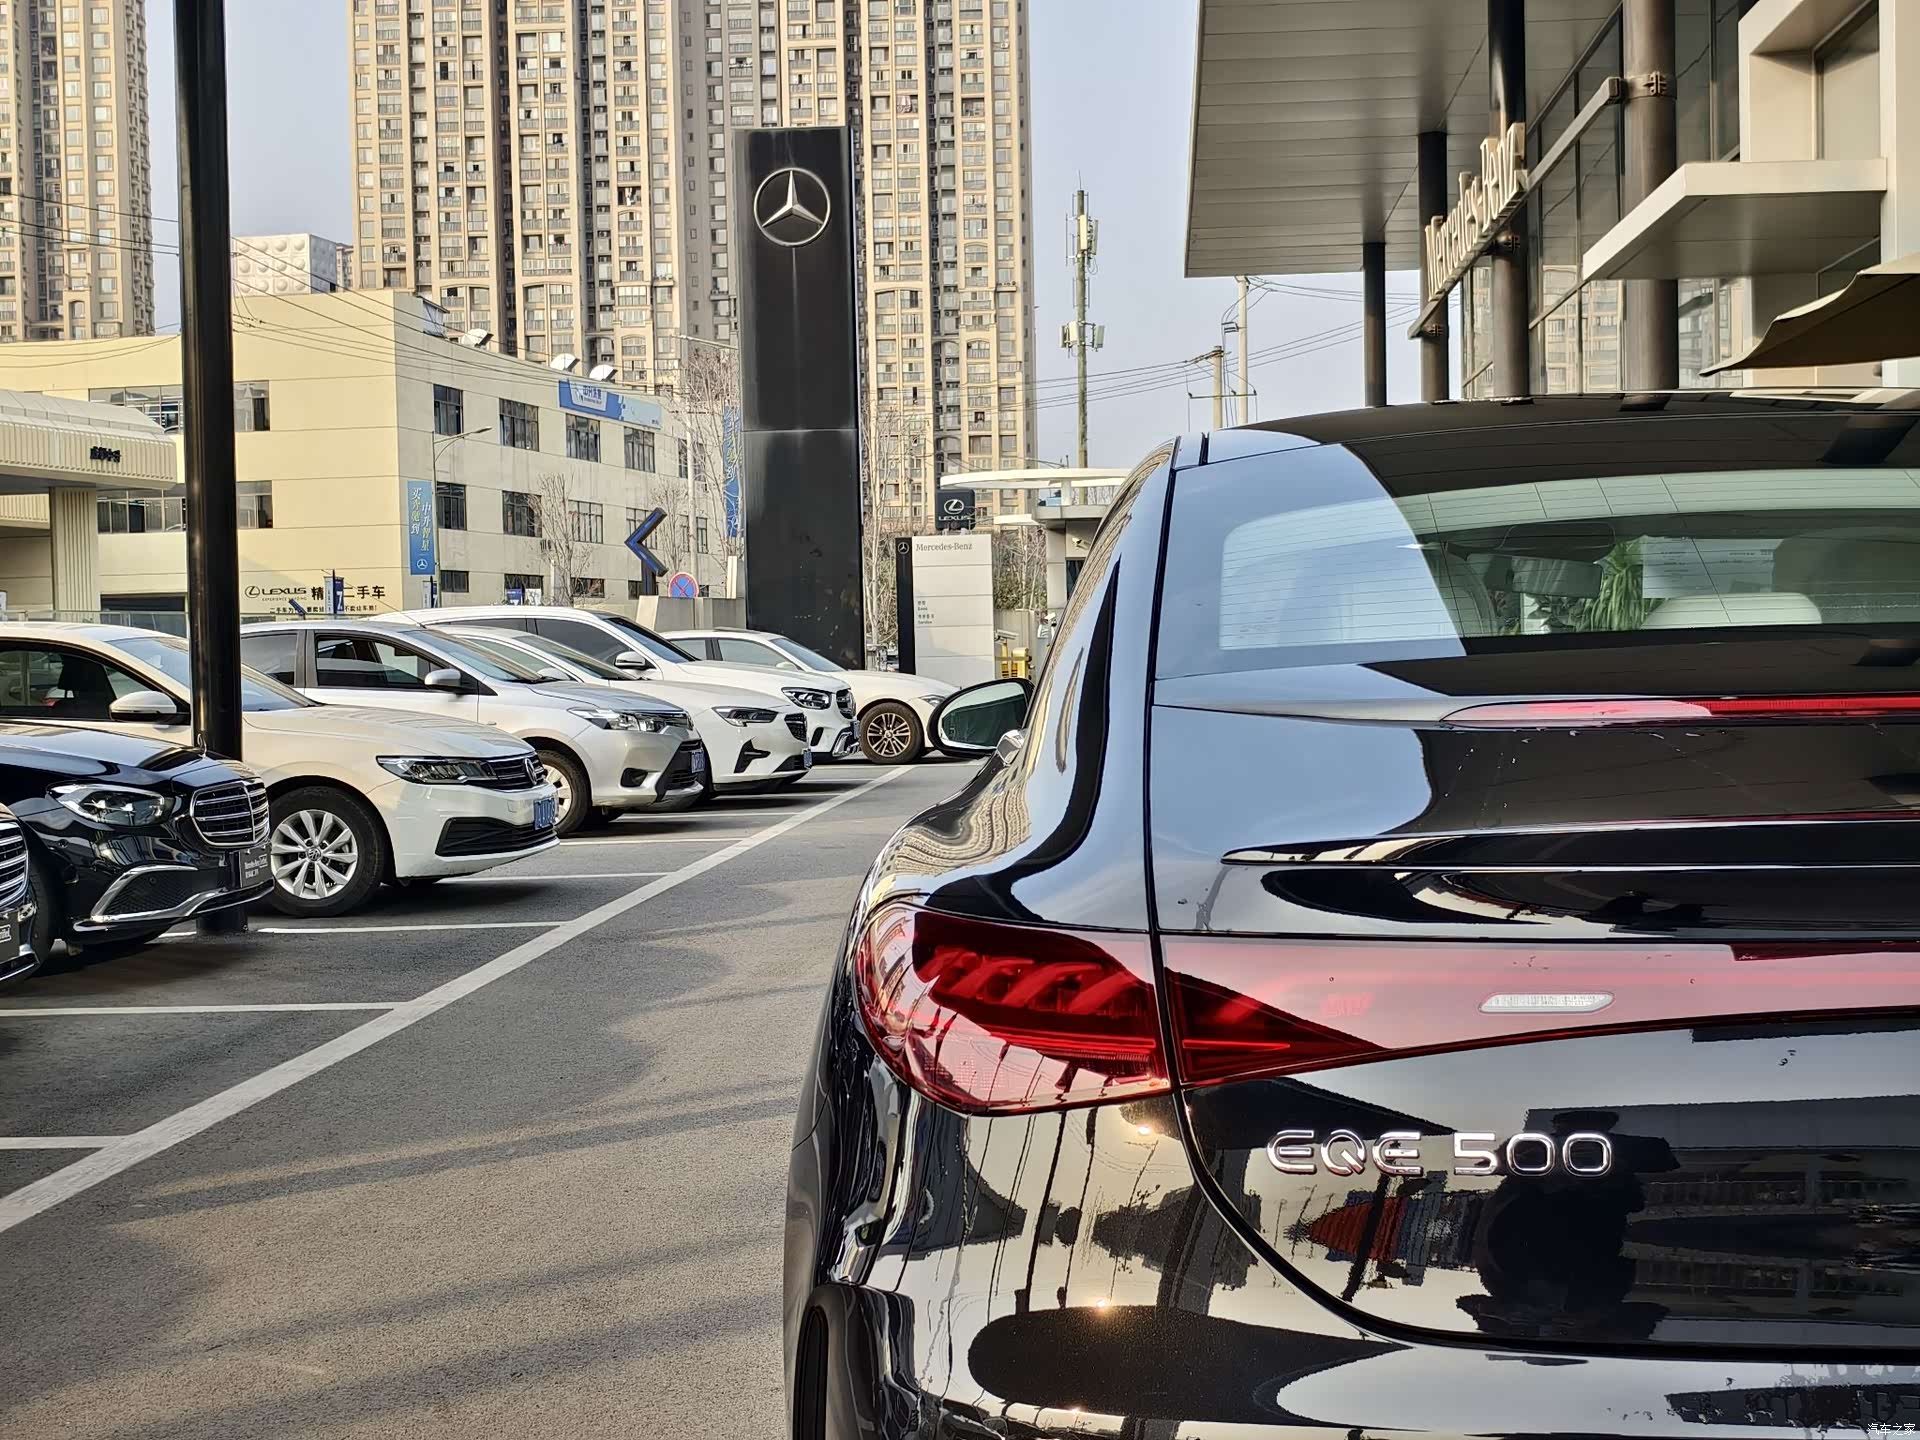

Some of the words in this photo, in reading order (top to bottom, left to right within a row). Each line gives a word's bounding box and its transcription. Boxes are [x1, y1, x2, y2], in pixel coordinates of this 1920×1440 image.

[1425, 122, 1528, 301] Mercedes-Benz
[915, 542, 973, 552] Mercedes-Benz
[262, 587, 307, 596] LEXUS
[311, 586, 386, 601] 精二手车
[1266, 1129, 1421, 1176] EQE
[1453, 1131, 1612, 1177] 500
